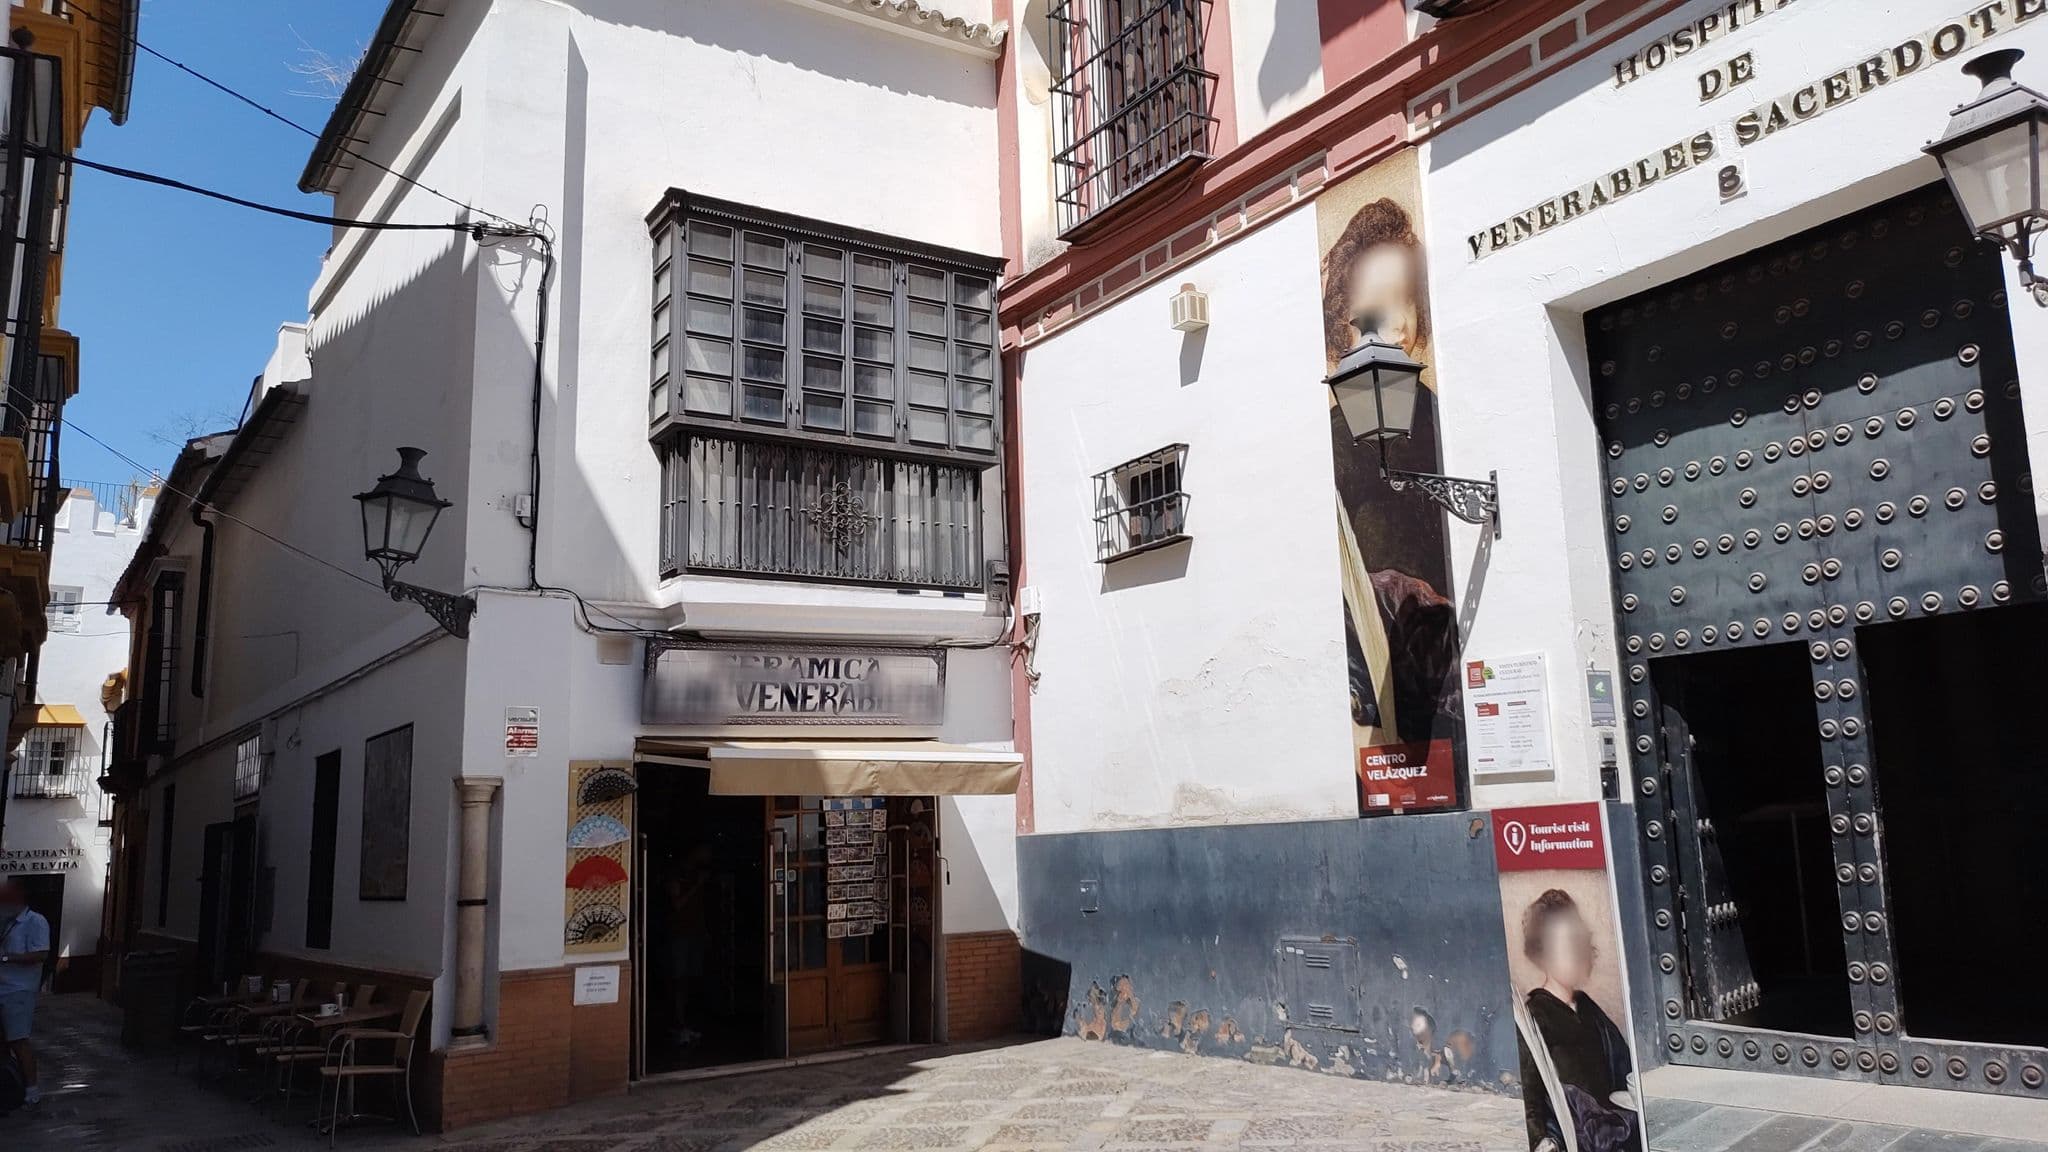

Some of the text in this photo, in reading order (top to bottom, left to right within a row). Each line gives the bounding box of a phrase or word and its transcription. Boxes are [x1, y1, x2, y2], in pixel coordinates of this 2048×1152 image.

[1613, 0, 1798, 89] HOSPIT
[1699, 51, 1757, 101] DE
[1467, 0, 2048, 261] VENERABLES SACERDOTE
[1719, 165, 1742, 198] 8
[729, 656, 882, 682] ERAMICA
[1366, 753, 1406, 767] CENTRO
[1366, 766, 1428, 781] VELÁZQUEZ
[1529, 821, 1591, 835] Tourist visit
[1530, 837, 1594, 853] Information
[0, 848, 84, 859] ESTAURANTE
[0, 860, 78, 872] OÑA ELVIRA
